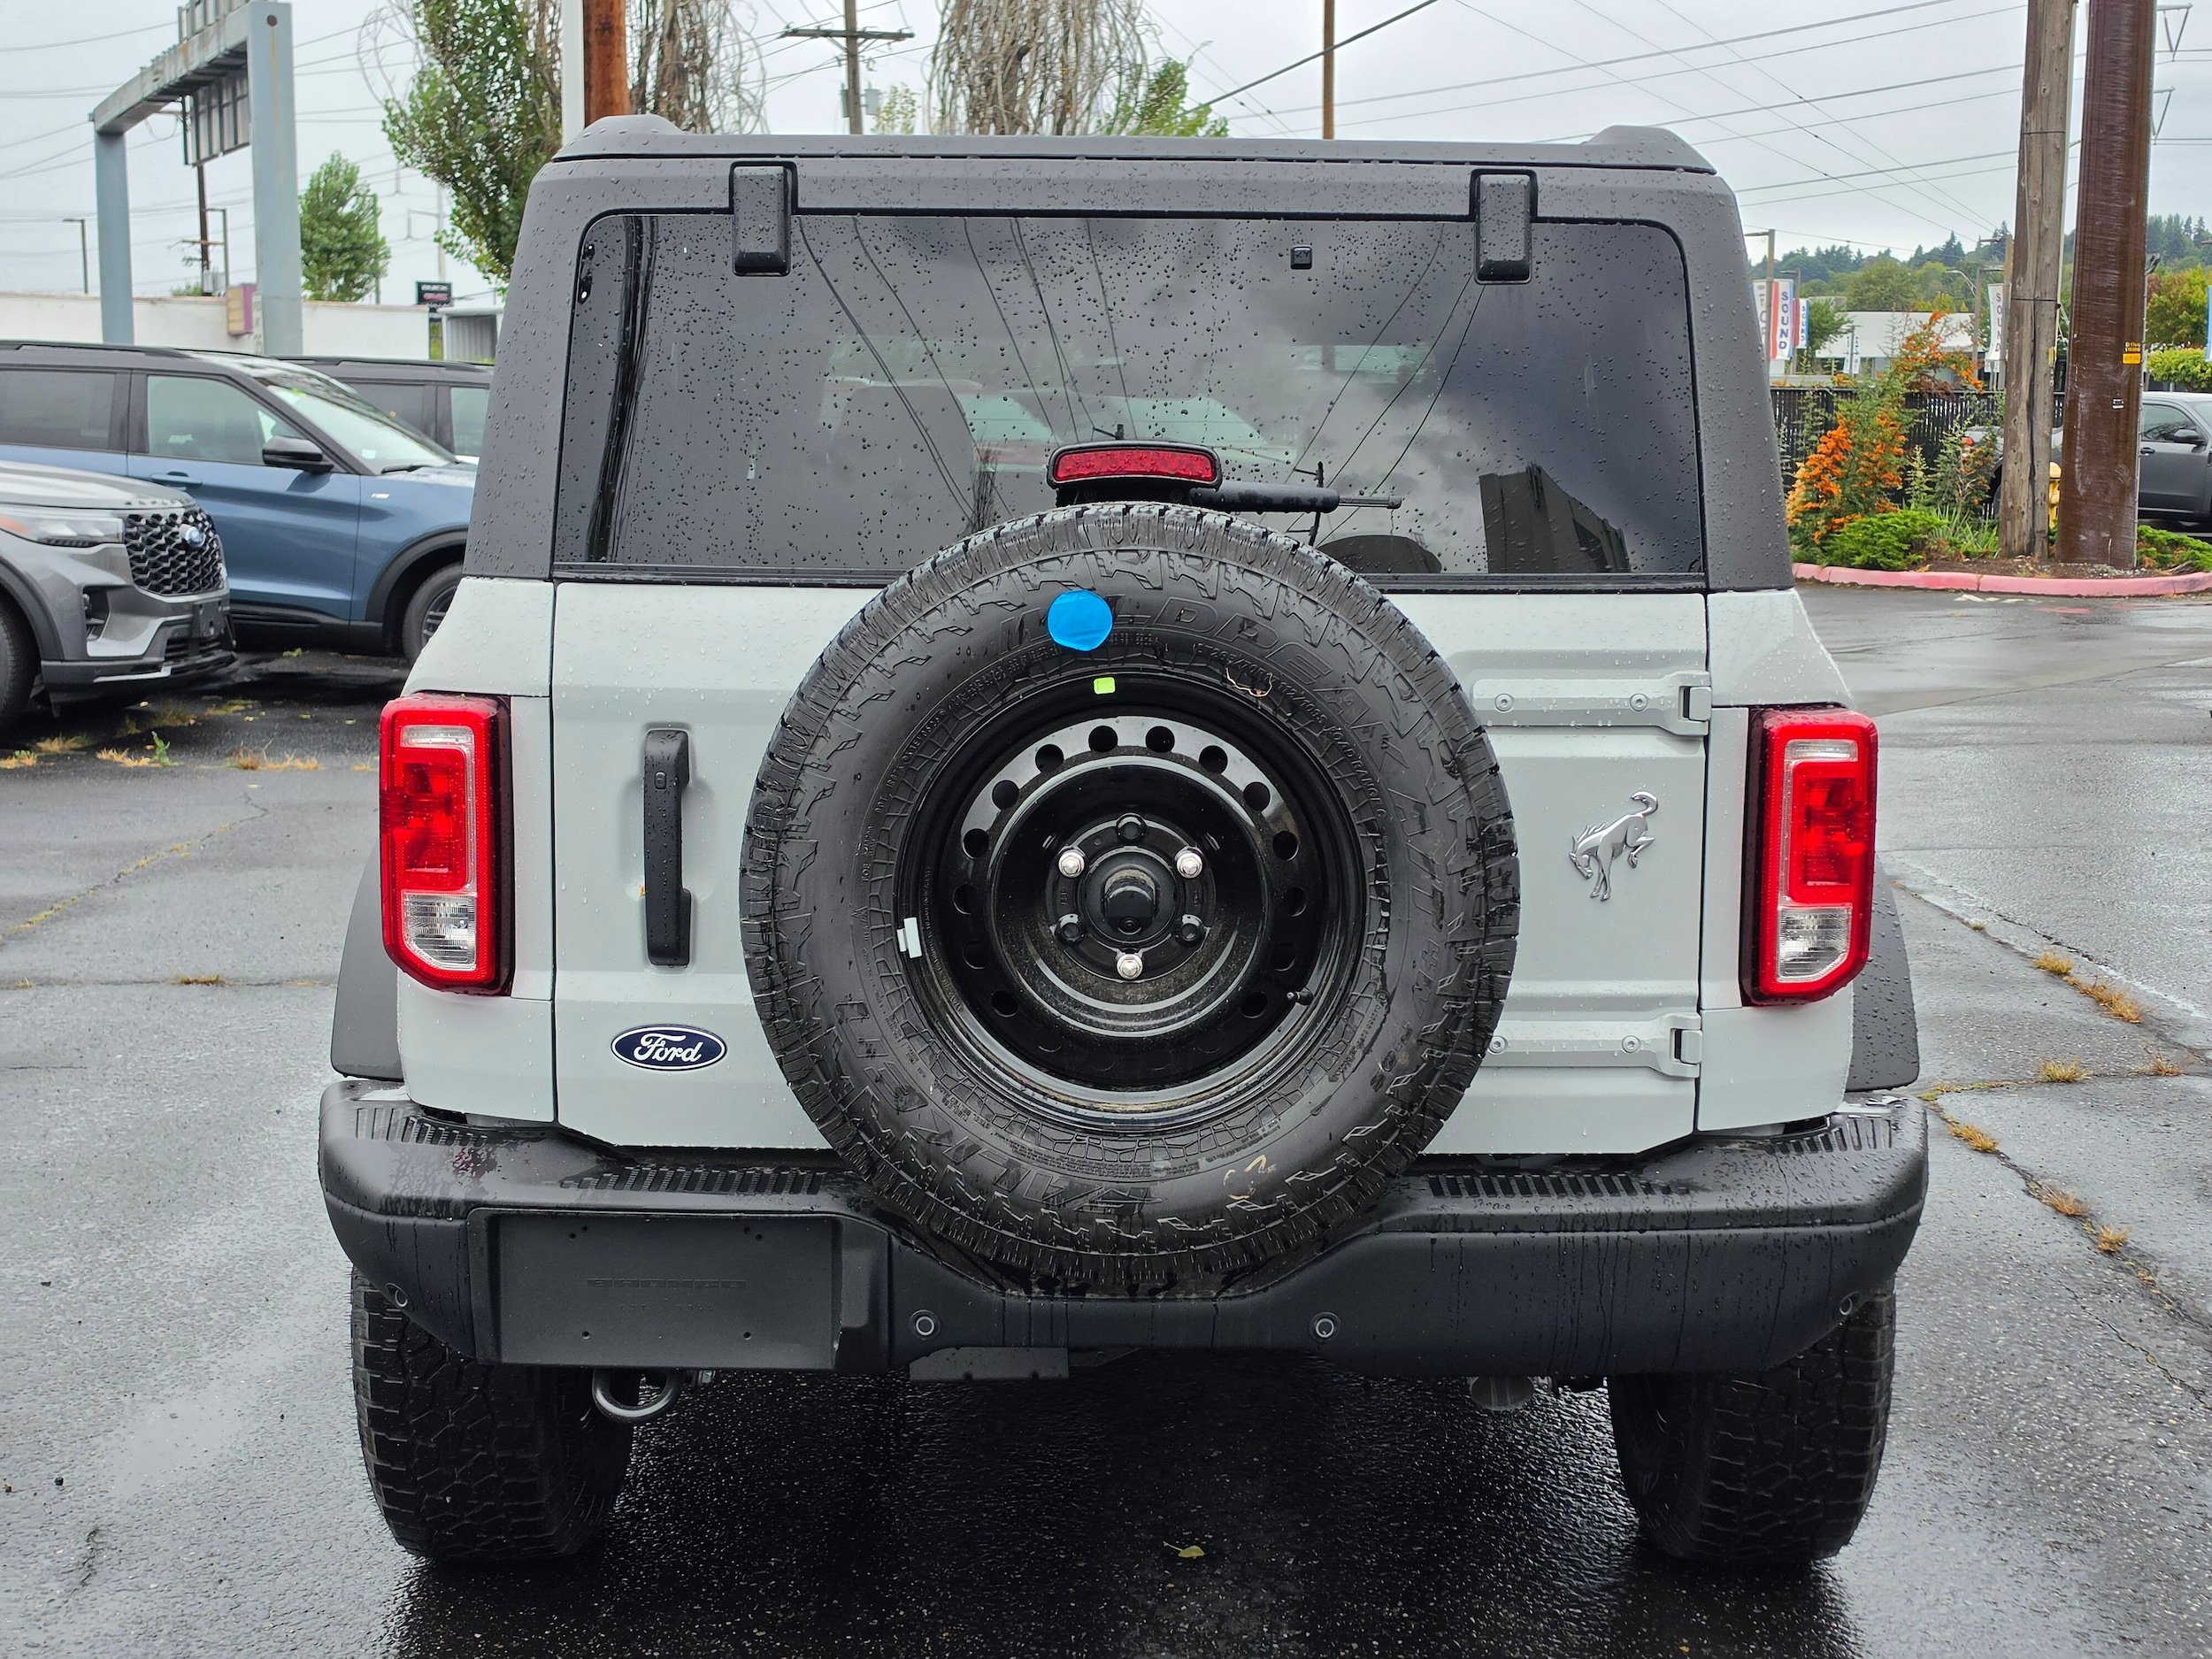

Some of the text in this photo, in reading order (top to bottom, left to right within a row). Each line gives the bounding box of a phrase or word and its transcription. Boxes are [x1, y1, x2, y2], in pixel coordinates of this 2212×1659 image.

[1778, 291, 1789, 349] SOUND
[1000, 594, 1410, 772] WLDPEAK
[634, 1033, 703, 1063] Ford
